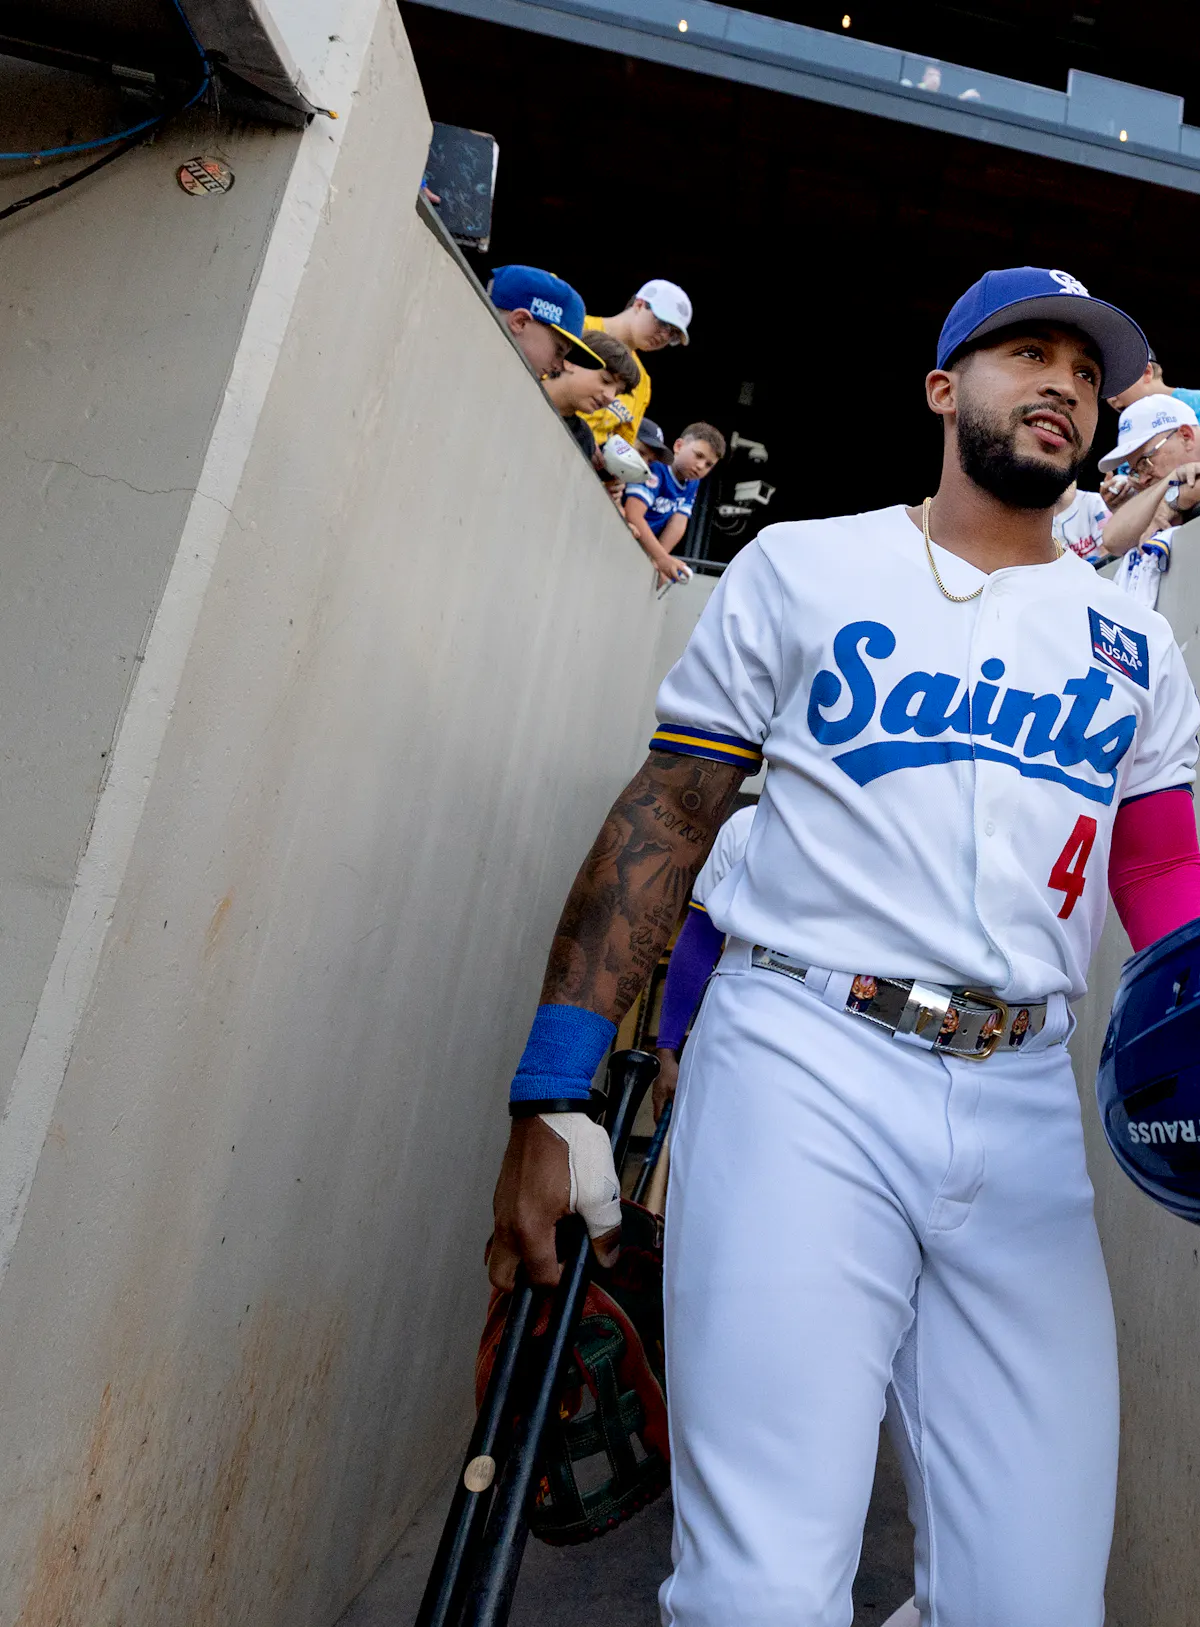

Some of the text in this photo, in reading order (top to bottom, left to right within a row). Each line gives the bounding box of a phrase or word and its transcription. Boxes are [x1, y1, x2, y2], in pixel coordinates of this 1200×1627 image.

[530, 305, 561, 324] LAKES
[532, 297, 563, 316] 10000
[1102, 641, 1138, 671] USAA
[807, 620, 1137, 774] Saints
[1047, 814, 1097, 920] 4
